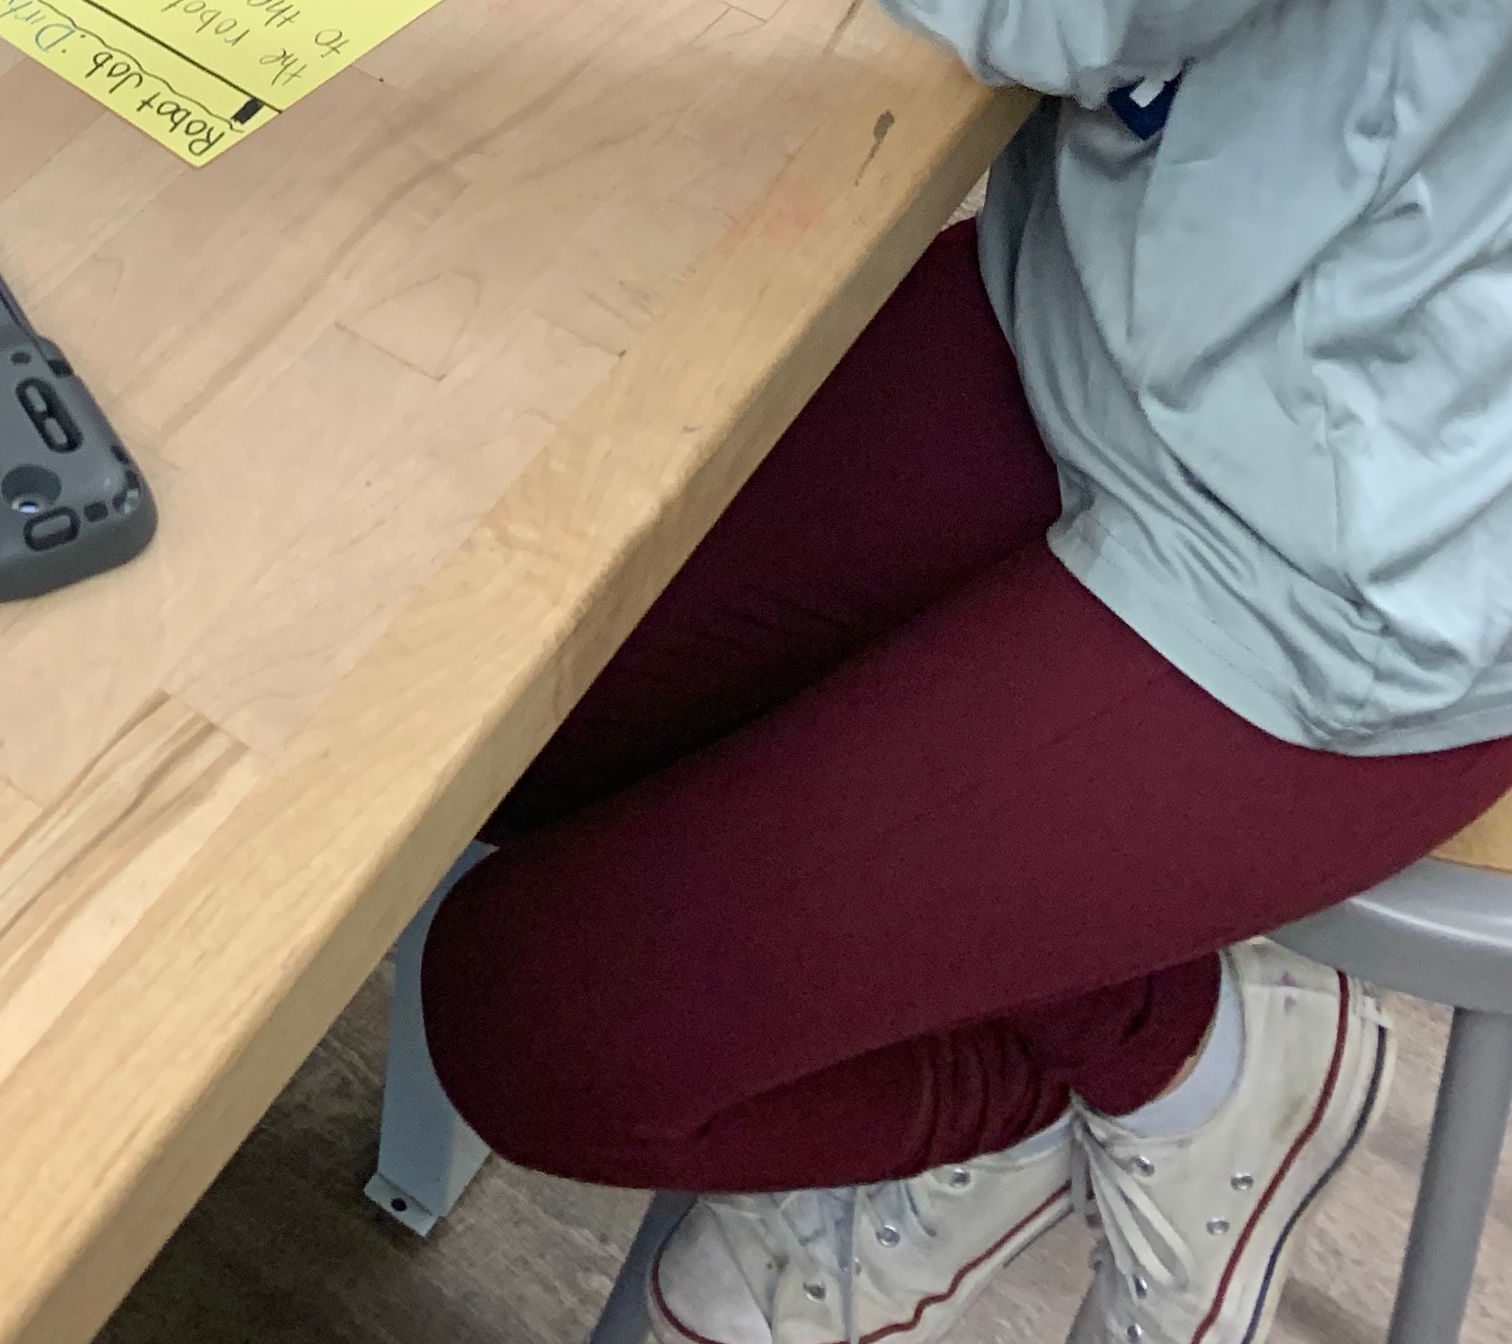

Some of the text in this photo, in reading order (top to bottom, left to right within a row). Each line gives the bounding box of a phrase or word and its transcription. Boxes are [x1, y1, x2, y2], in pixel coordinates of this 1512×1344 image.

[314, 28, 350, 59] to
[259, 48, 308, 87] the
[136, 91, 225, 156] Robot
